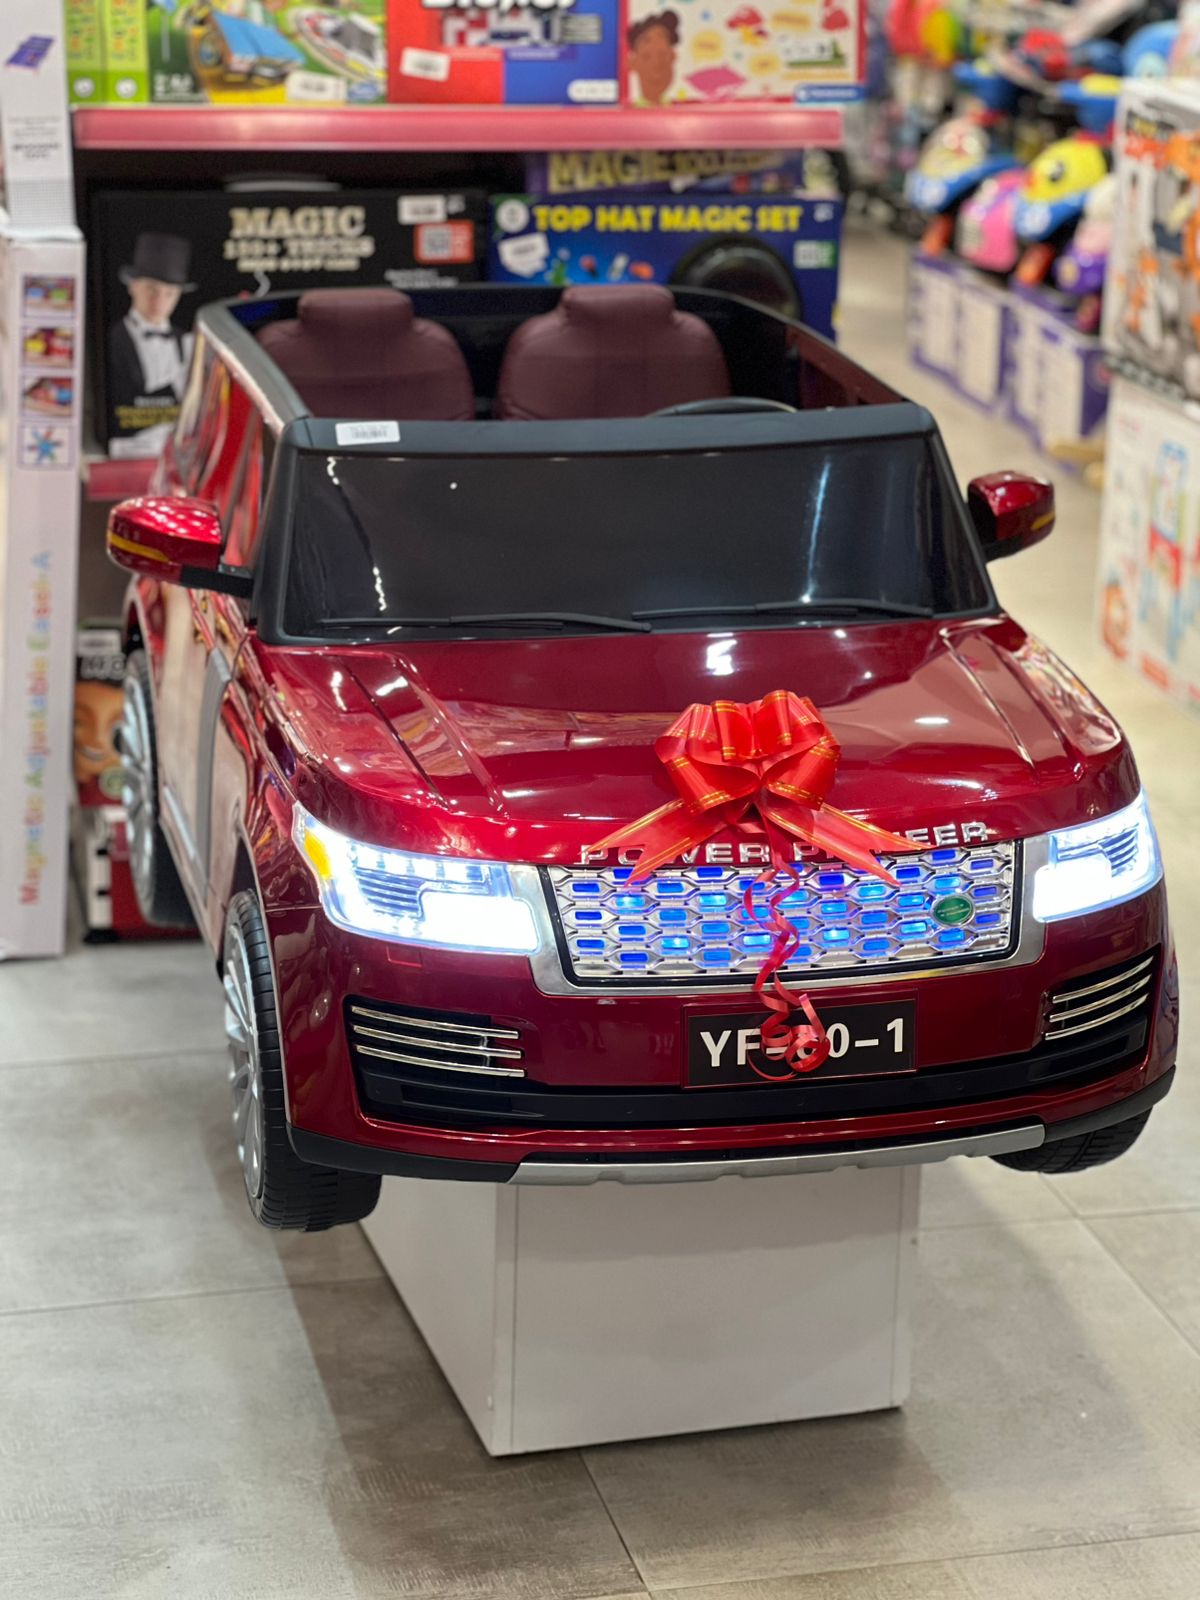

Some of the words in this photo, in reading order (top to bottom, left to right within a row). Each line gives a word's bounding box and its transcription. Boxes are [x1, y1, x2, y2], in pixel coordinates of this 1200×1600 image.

[229, 206, 367, 238] MAGIC
[533, 205, 592, 232] TOP
[596, 205, 656, 232] HAT
[659, 205, 753, 232] MAGIC
[756, 205, 803, 232] SET
[24, 656, 51, 788] Adjustable
[20, 794, 48, 906] Magnetic
